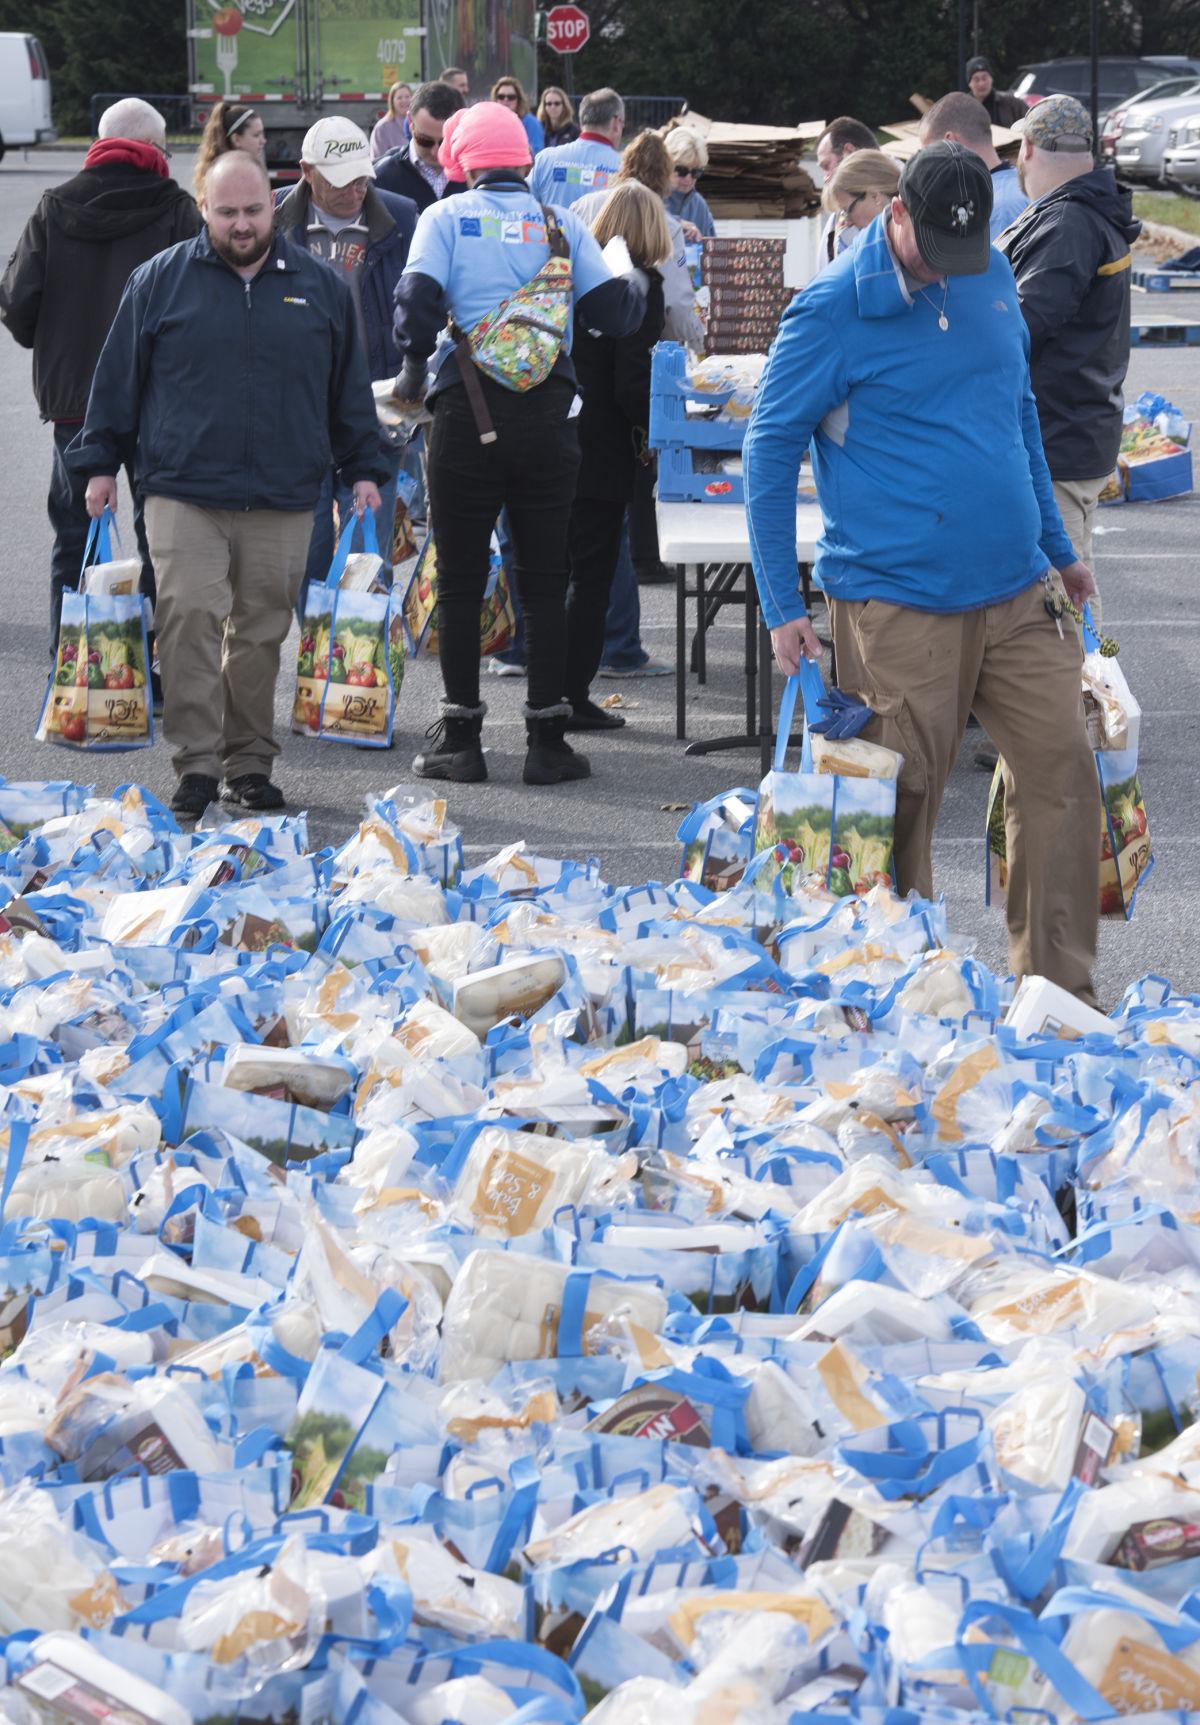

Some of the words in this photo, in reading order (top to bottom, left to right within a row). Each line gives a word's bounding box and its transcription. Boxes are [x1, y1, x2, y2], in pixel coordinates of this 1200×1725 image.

[547, 19, 586, 40] STOP
[376, 38, 406, 64] 4079
[324, 139, 366, 158] Rams
[458, 206, 521, 221] COMMUNITY
